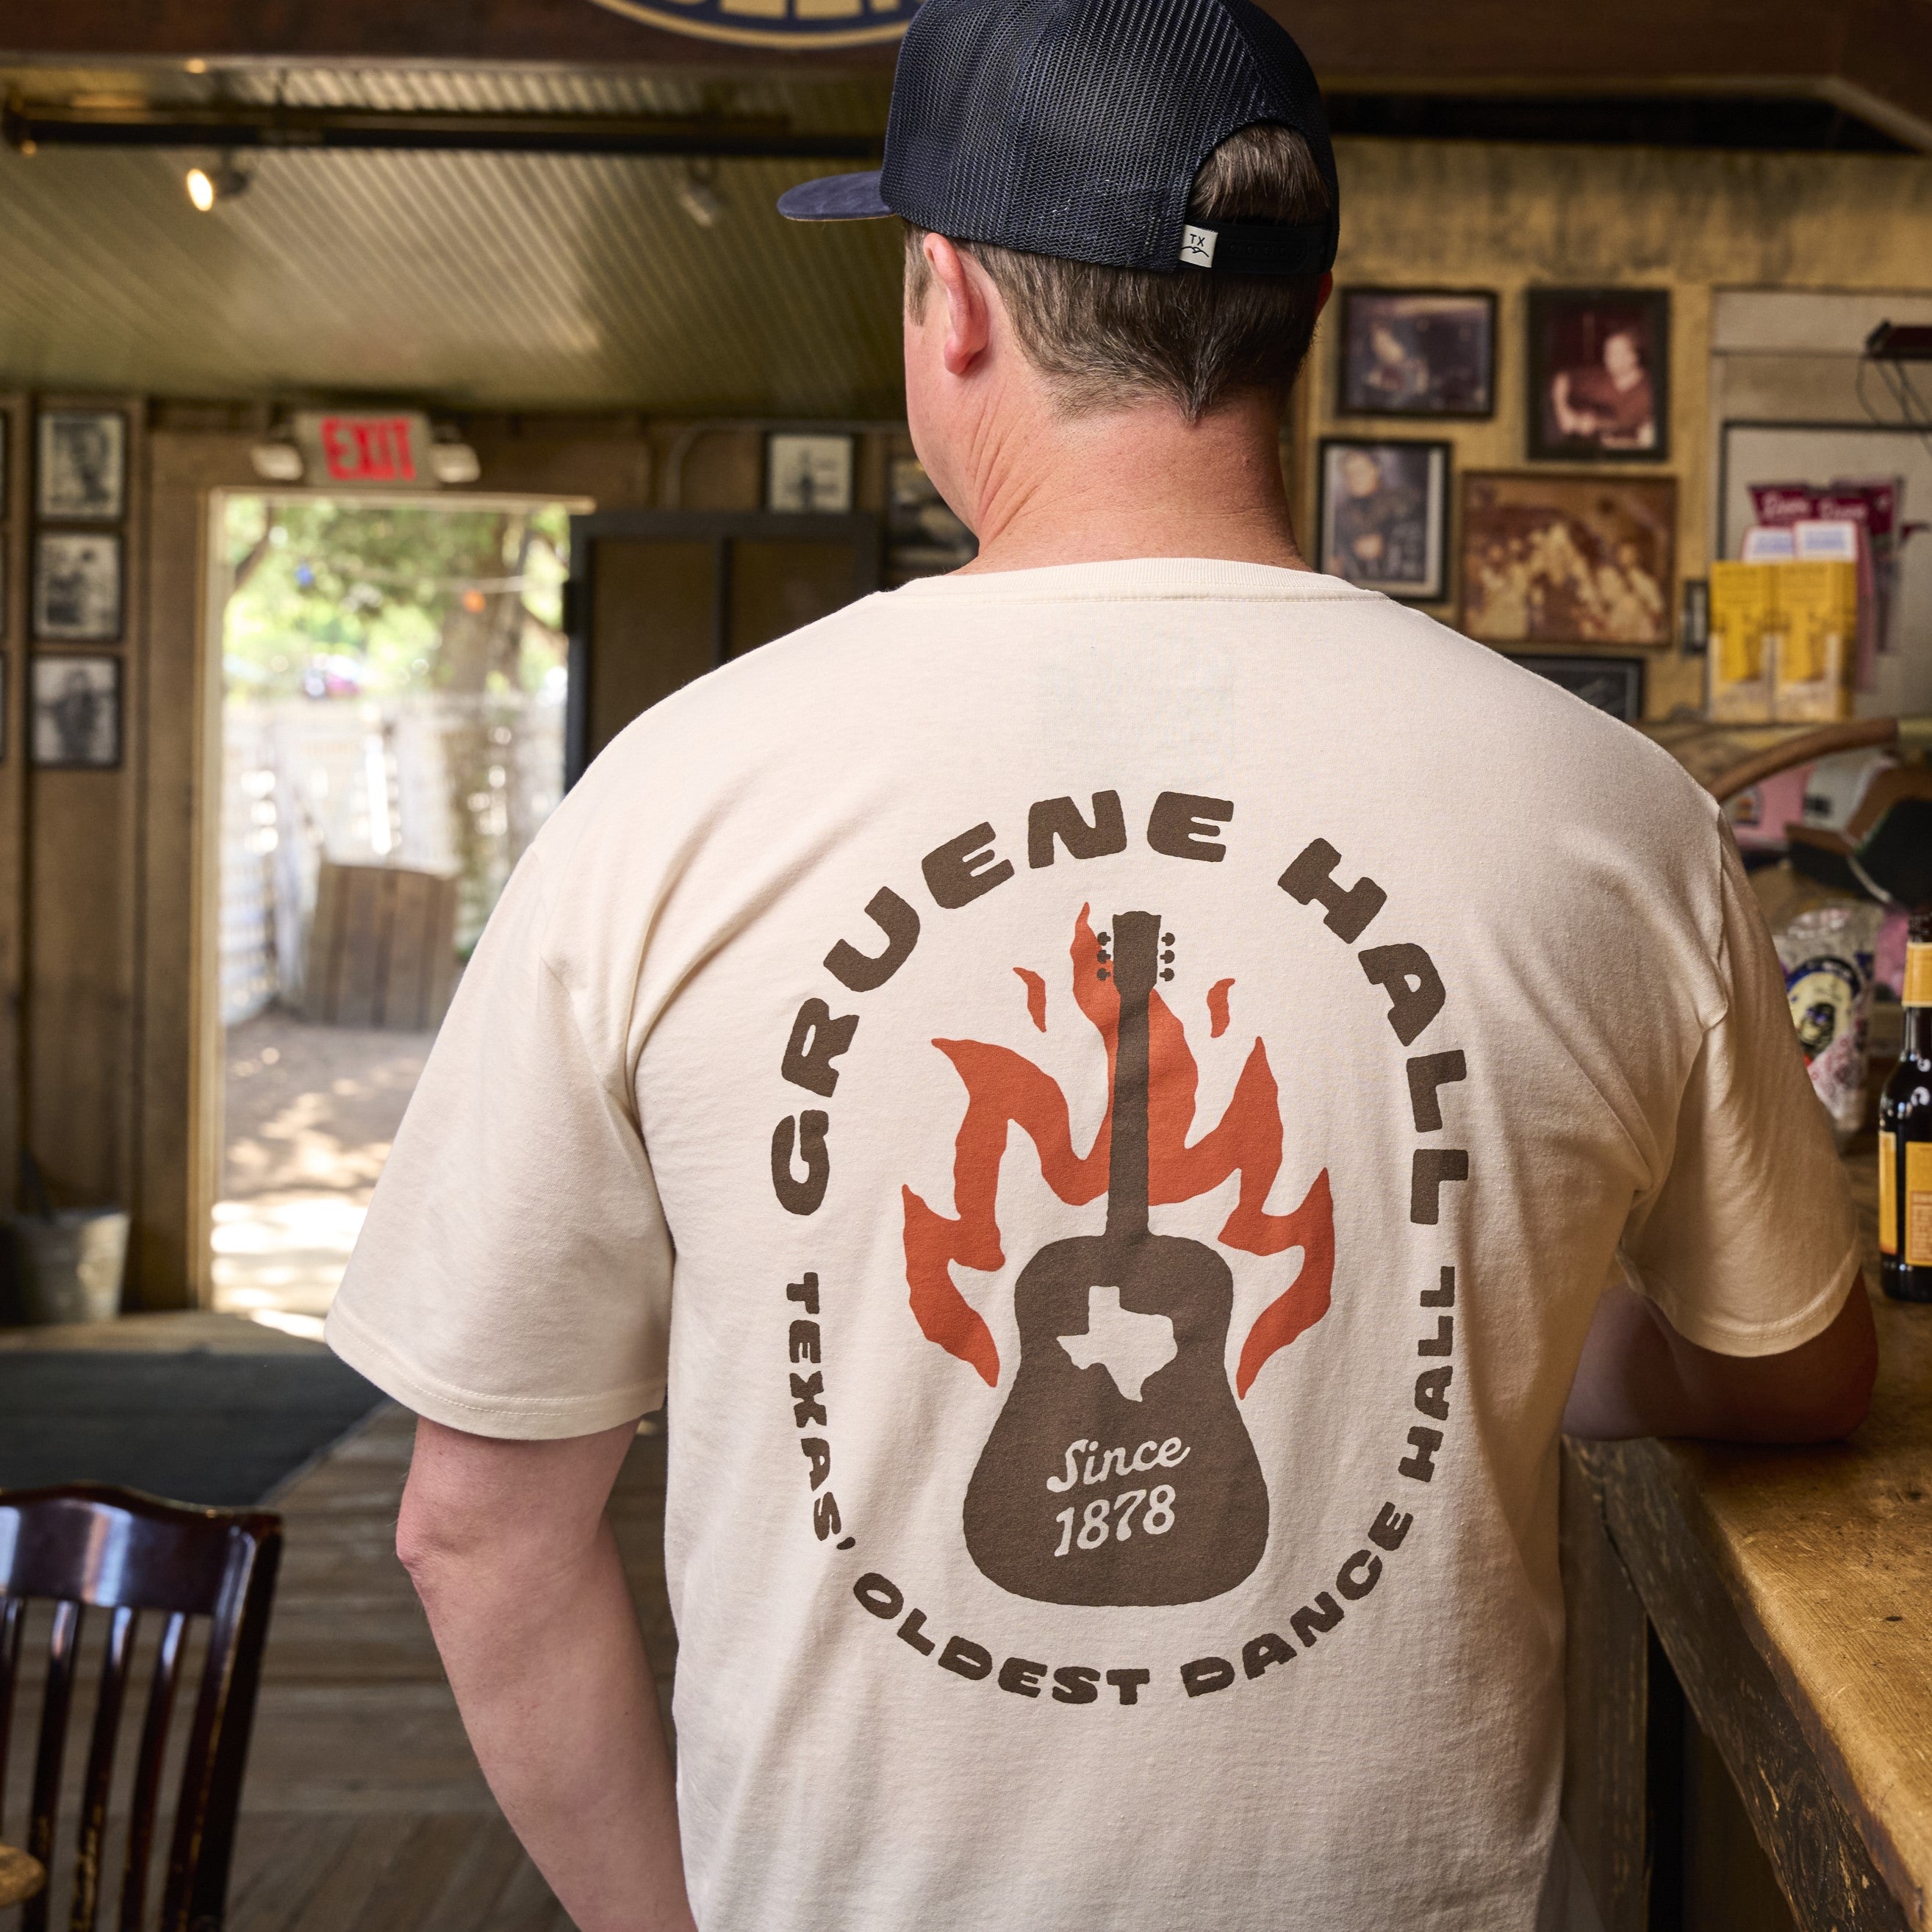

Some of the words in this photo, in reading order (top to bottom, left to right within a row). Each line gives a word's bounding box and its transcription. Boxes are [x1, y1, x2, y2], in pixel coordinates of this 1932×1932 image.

[1190, 233, 1205, 247] TX
[320, 416, 417, 481] EXIT
[772, 789, 1234, 1216] GRUENE
[1277, 837, 1470, 1227] HALL
[852, 1572, 1151, 1706] OLDEST
[1179, 1501, 1414, 1698] DANCE
[1398, 1265, 1456, 1483] HALL
[1046, 1437, 1191, 1493] Since
[1054, 1484, 1177, 1557] 1878
